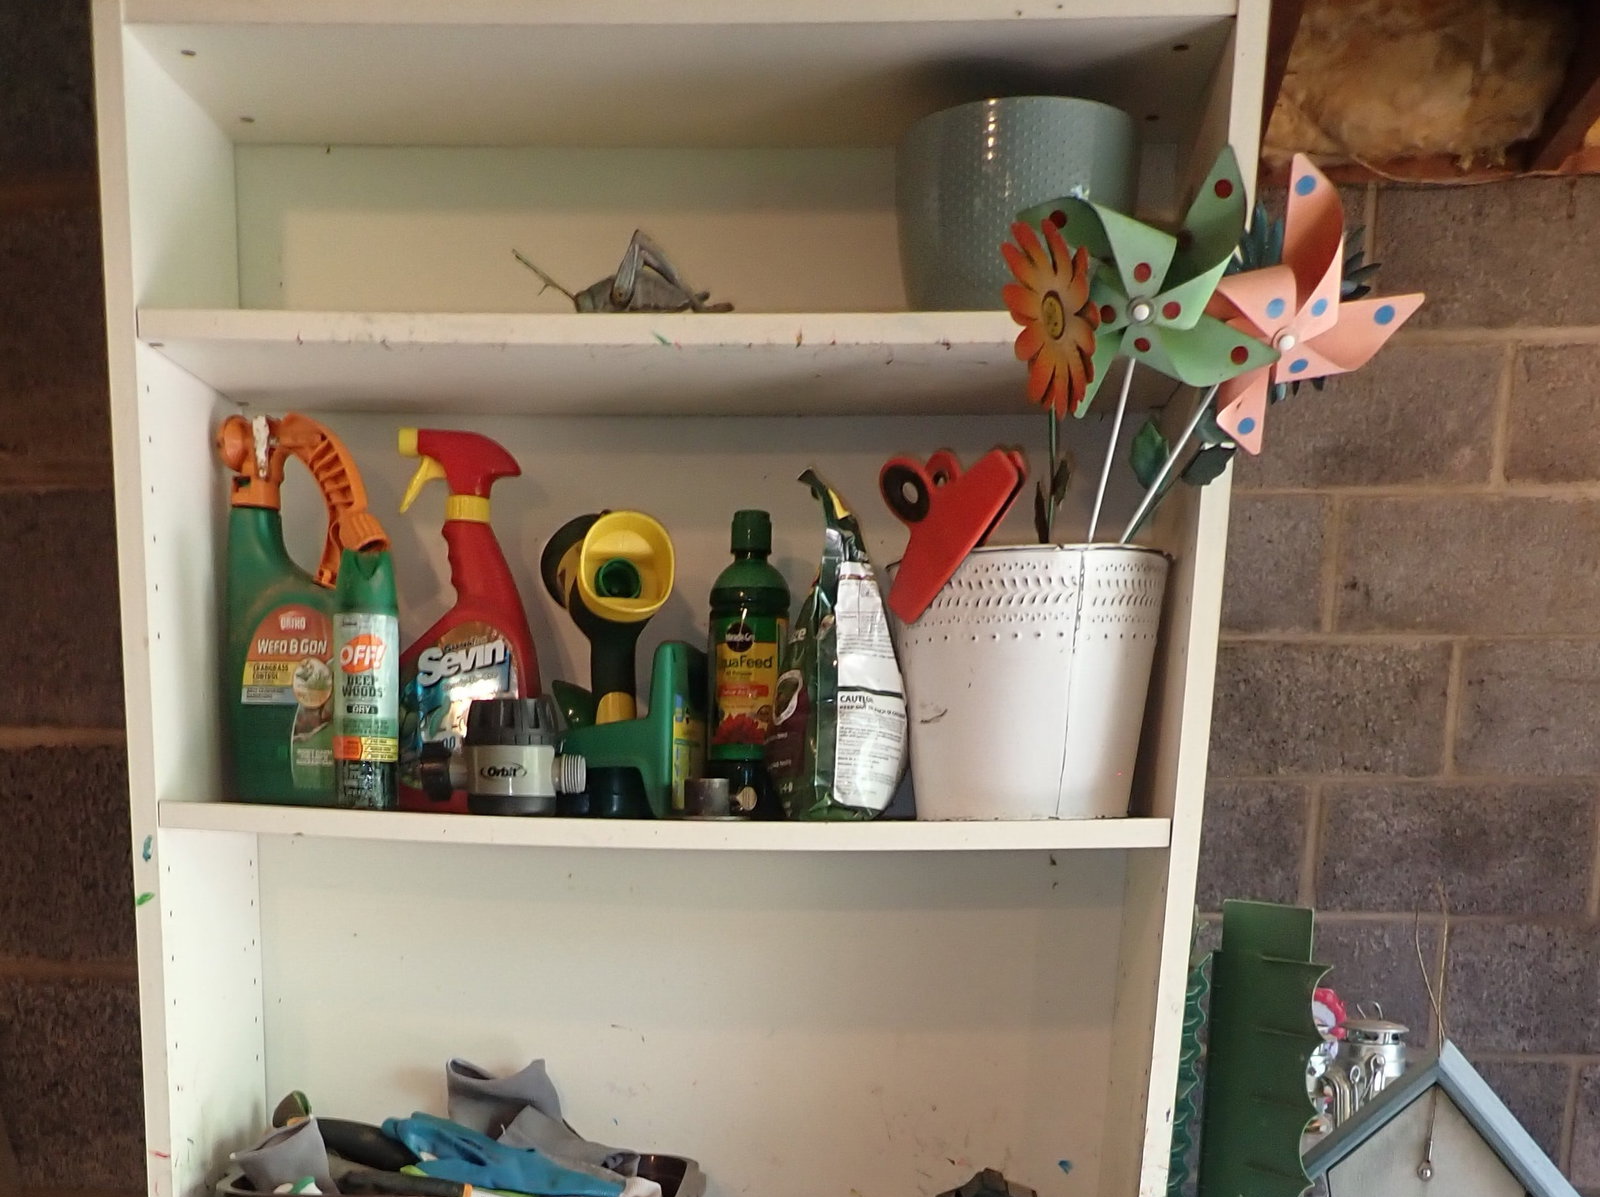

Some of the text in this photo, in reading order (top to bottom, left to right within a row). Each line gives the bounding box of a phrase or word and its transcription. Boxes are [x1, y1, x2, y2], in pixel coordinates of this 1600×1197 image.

[289, 638, 299, 656] B
[300, 639, 328, 656] GON
[340, 645, 387, 670] OFF!
[417, 638, 508, 688] Sevin
[342, 686, 384, 698] WOODS
[487, 765, 518, 778] Orbit
